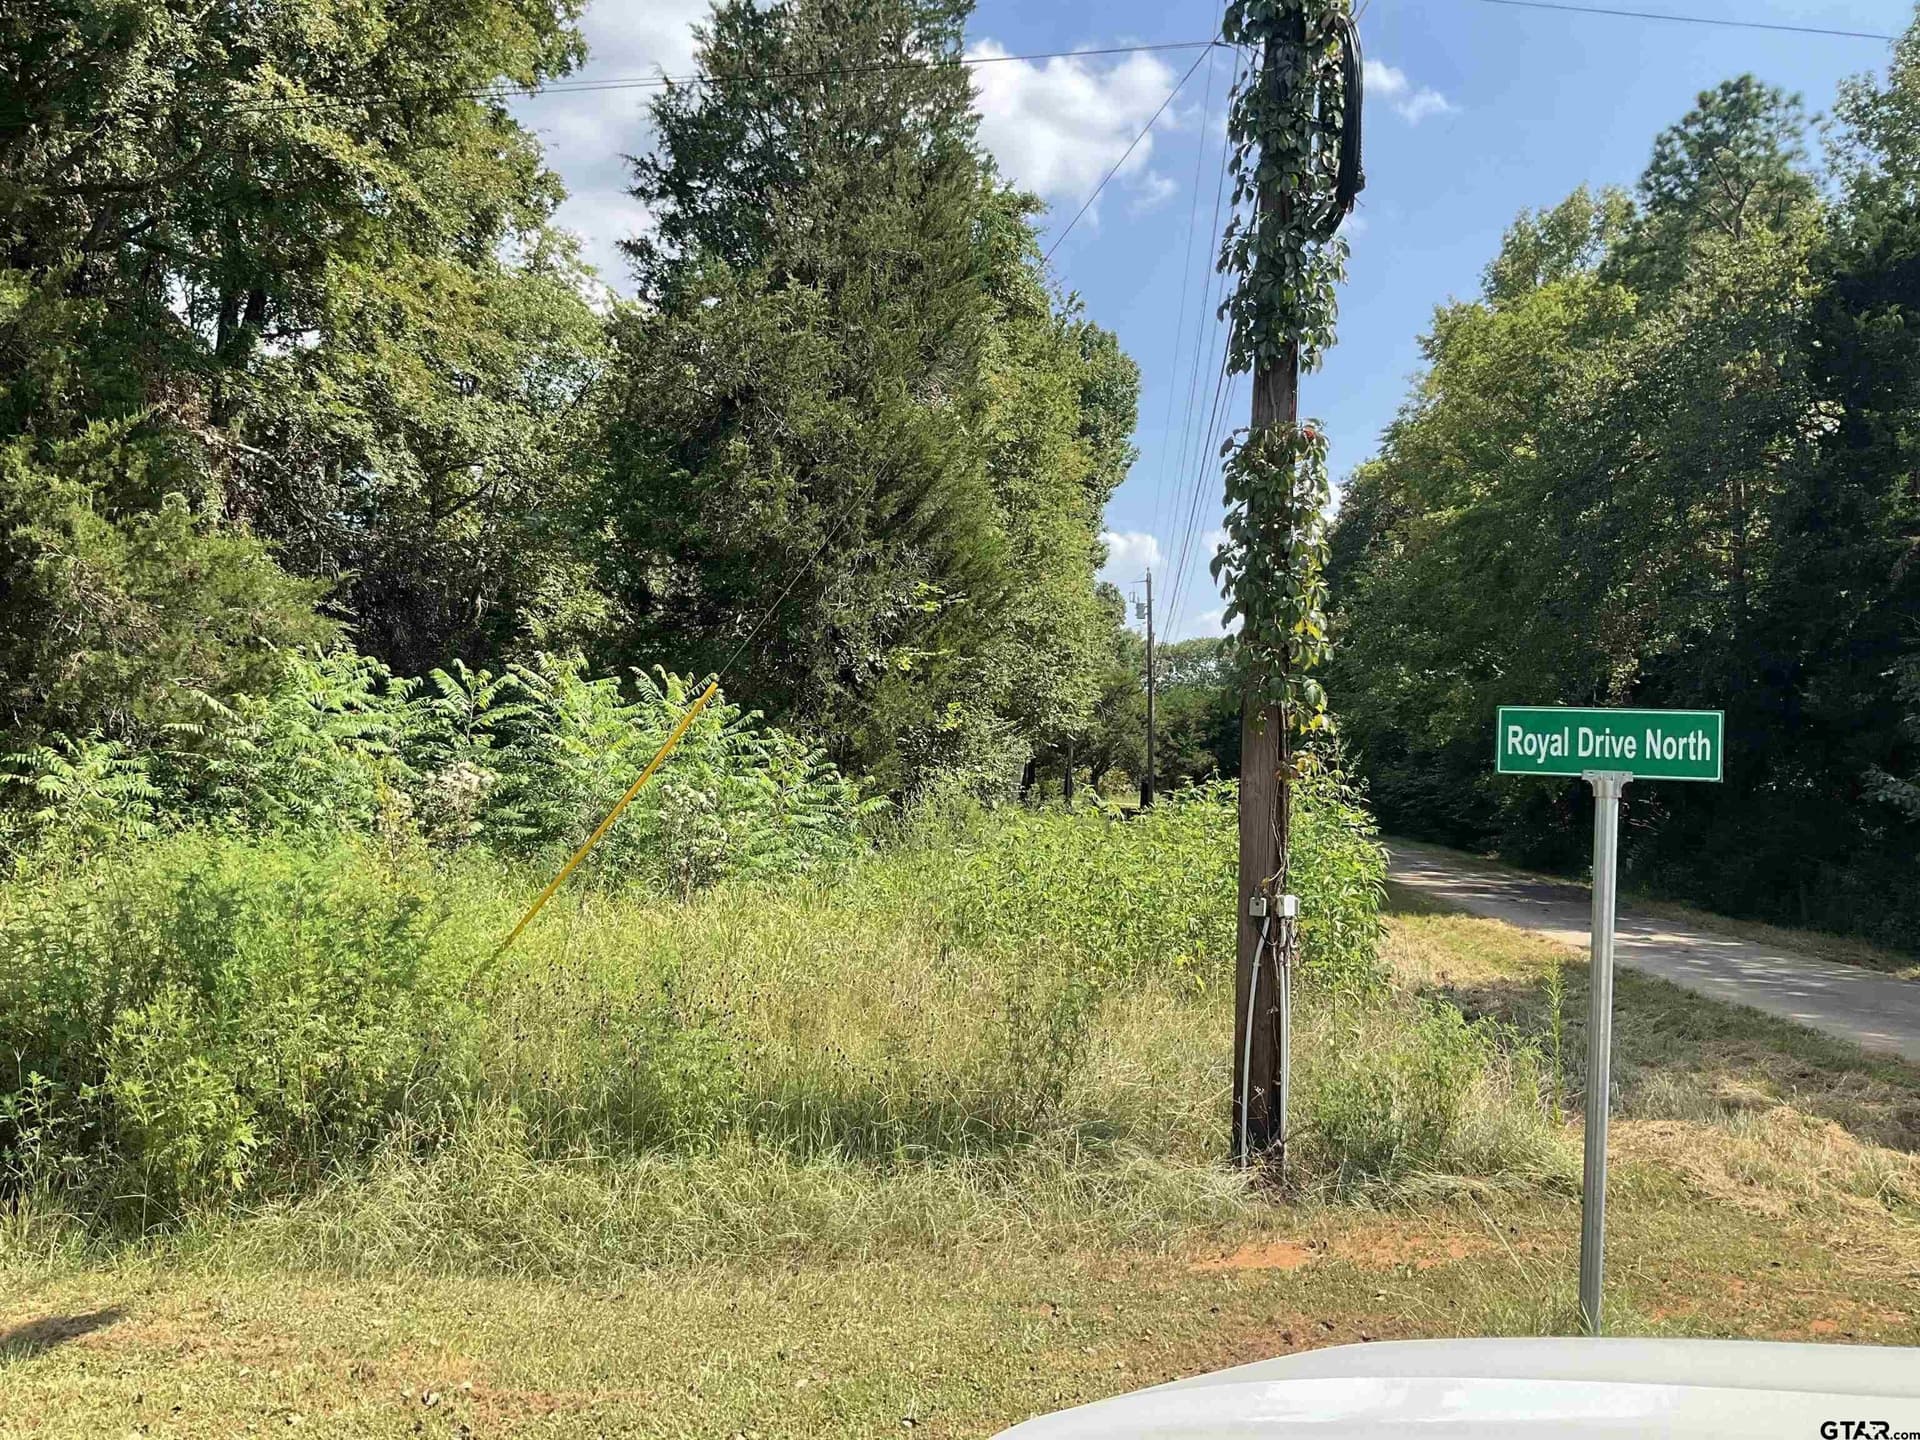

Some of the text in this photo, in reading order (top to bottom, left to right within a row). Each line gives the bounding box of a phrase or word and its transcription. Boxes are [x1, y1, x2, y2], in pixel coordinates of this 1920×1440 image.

[1507, 725, 1711, 764] Royal Drive North
